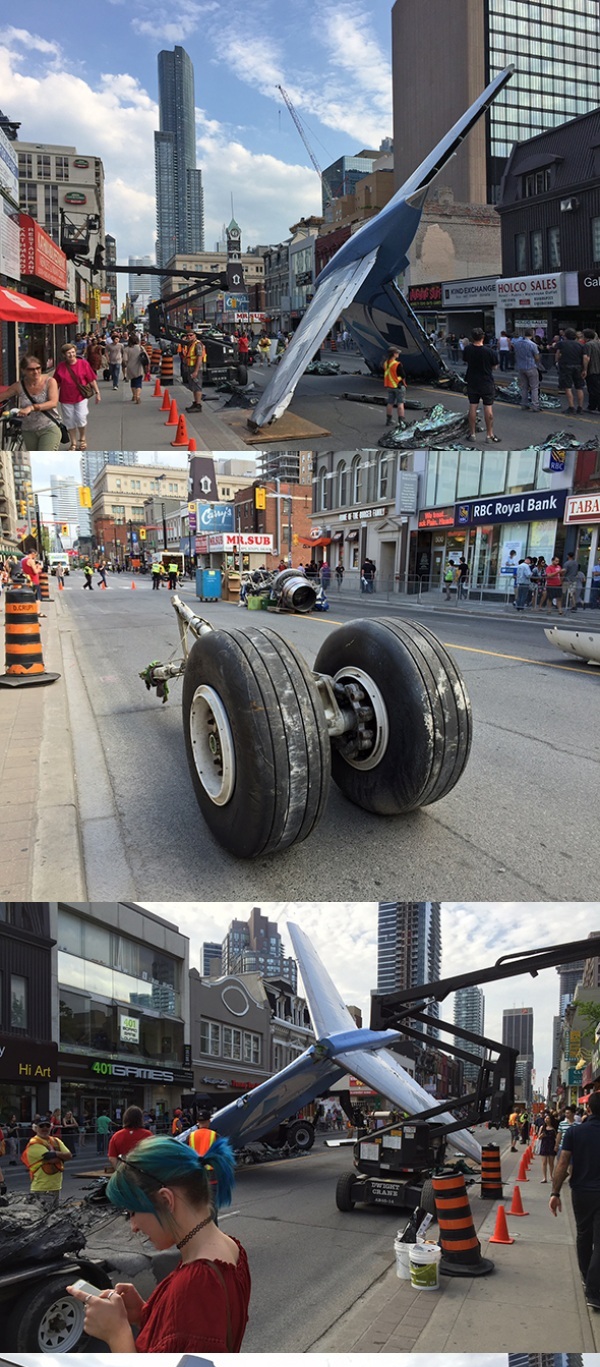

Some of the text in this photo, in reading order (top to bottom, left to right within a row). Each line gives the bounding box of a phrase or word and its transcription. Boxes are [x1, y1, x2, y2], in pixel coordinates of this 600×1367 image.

[464, 284, 496, 294] EXCHANGE
[498, 278, 557, 293] HOLCO SALES
[550, 461, 564, 470] RBC
[473, 495, 558, 517] RBC Royal Bank
[201, 507, 232, 525] Carry's
[226, 535, 271, 546] MR.SUB
[19, 1063, 51, 1078] Hi Art
[371, 1182, 400, 1190] DWIGHT
